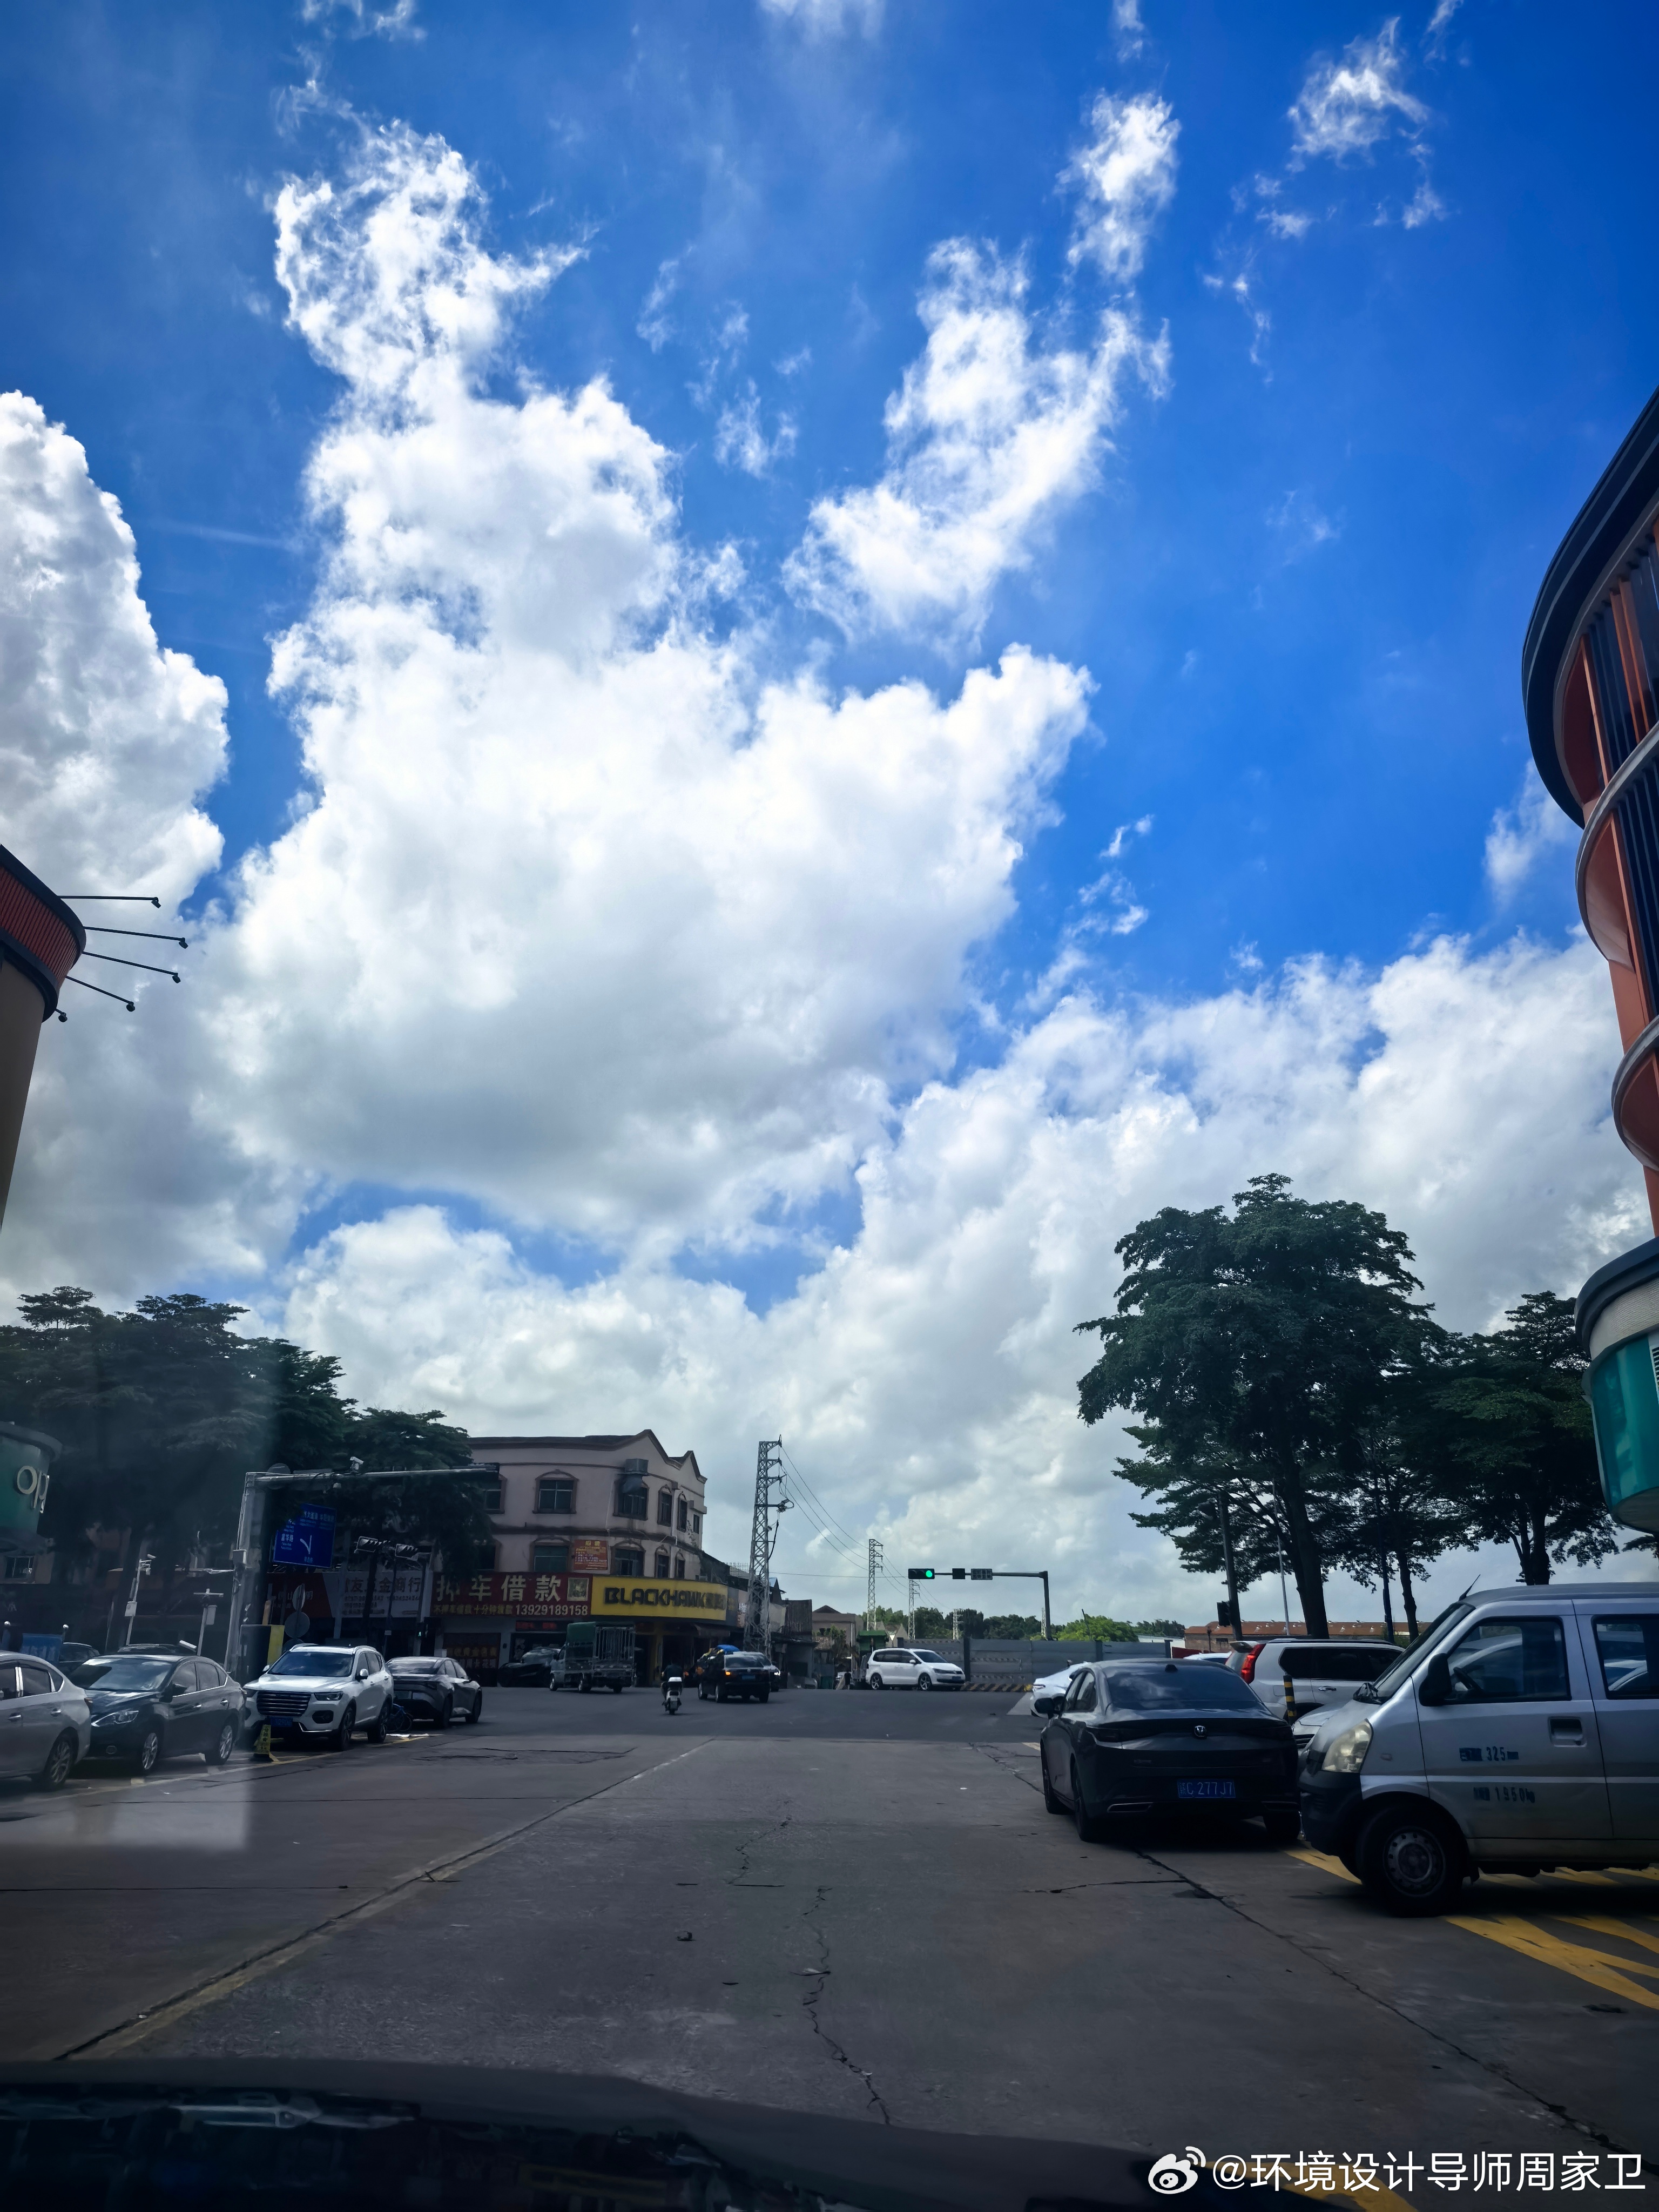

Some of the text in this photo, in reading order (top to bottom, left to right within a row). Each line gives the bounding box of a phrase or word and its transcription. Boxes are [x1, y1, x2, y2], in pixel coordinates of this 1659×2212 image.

[338, 1577, 420, 1593] 友金商行
[516, 1604, 588, 1616] 13929189158
